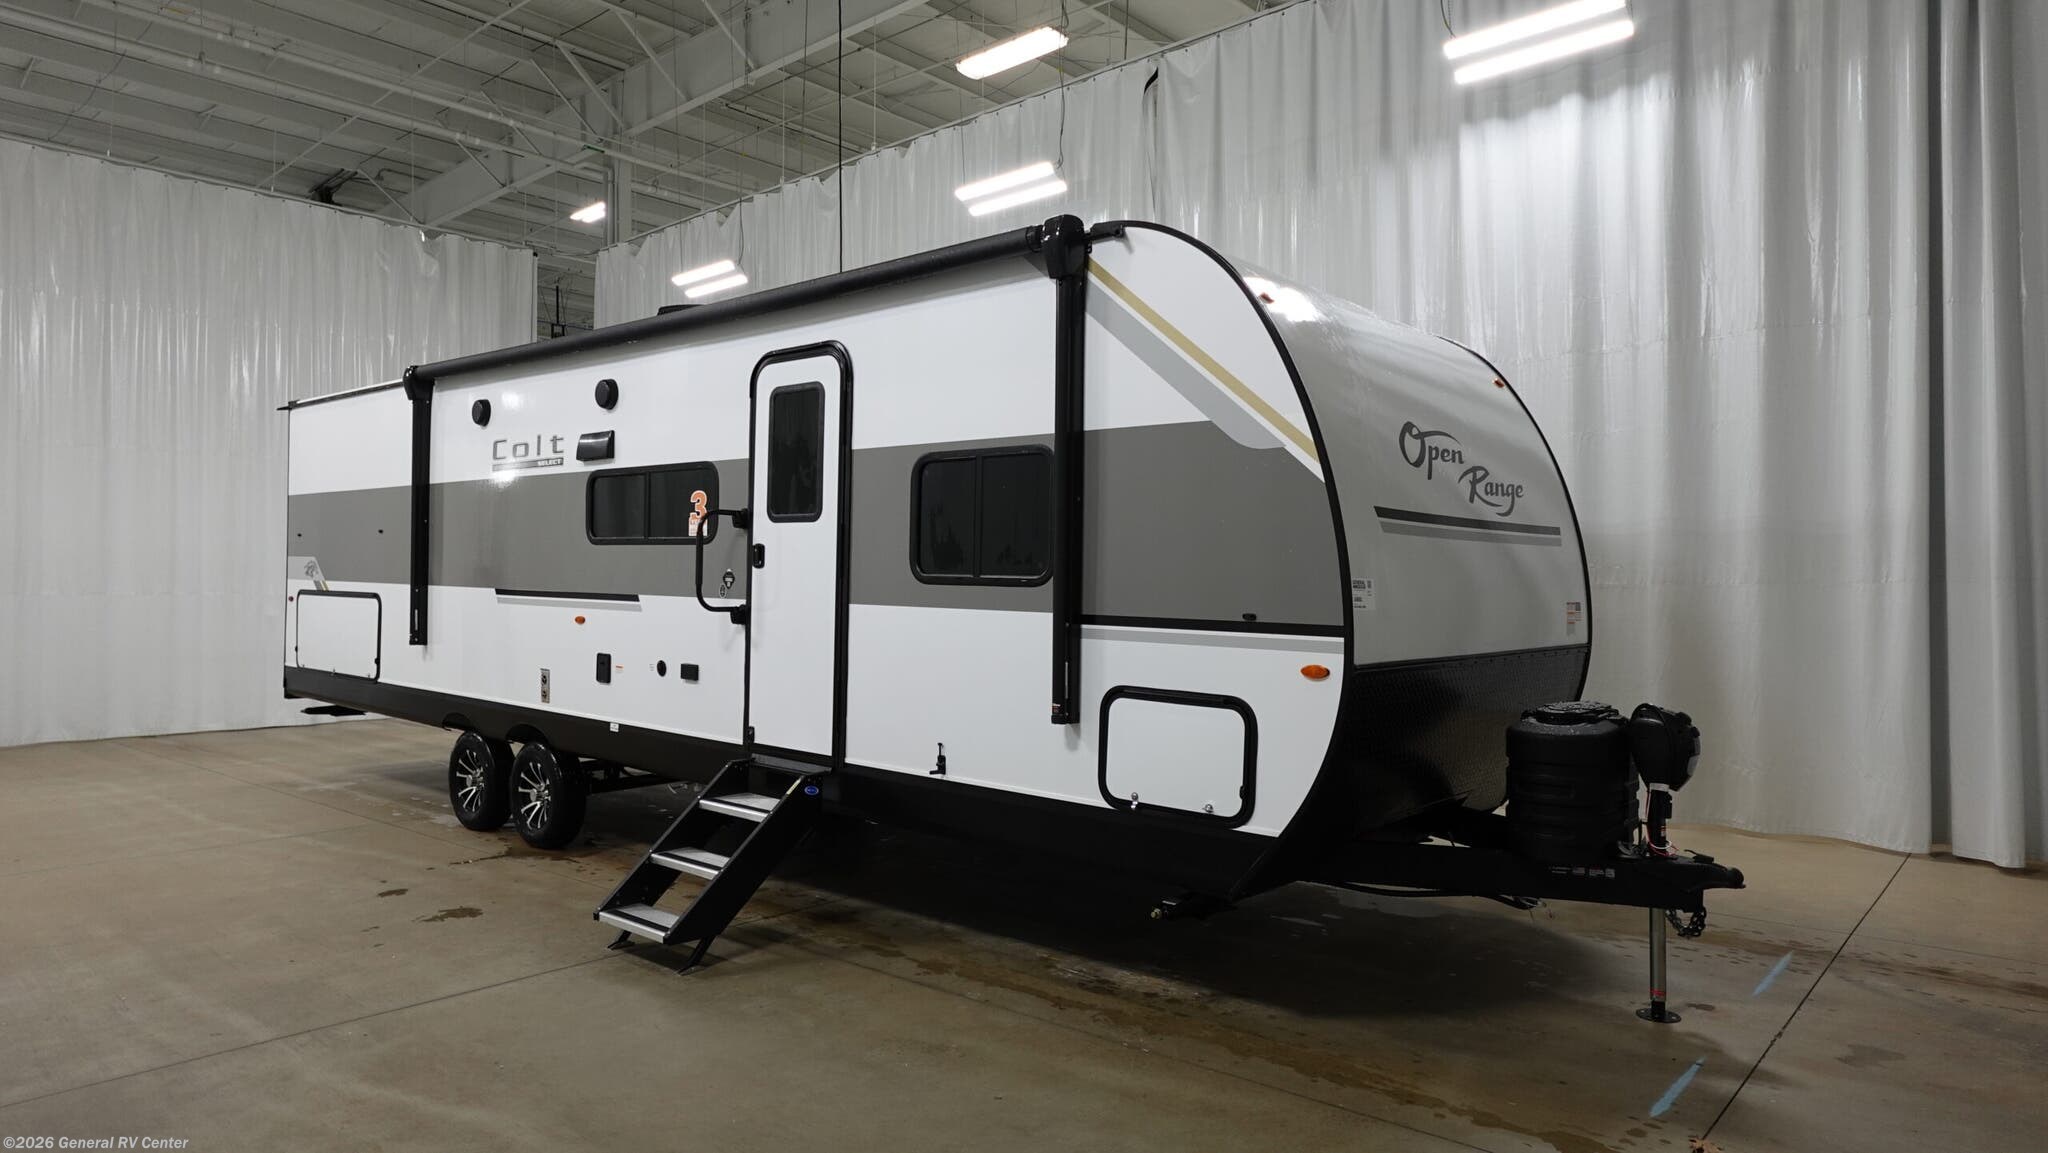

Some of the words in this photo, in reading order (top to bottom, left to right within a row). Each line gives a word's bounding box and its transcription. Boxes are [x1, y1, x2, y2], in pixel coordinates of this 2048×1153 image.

[493, 435, 564, 460] Colt
[537, 458, 562, 467] SELECT
[1399, 421, 1464, 481] Open
[690, 490, 707, 520] 3
[1458, 465, 1524, 517] Range
